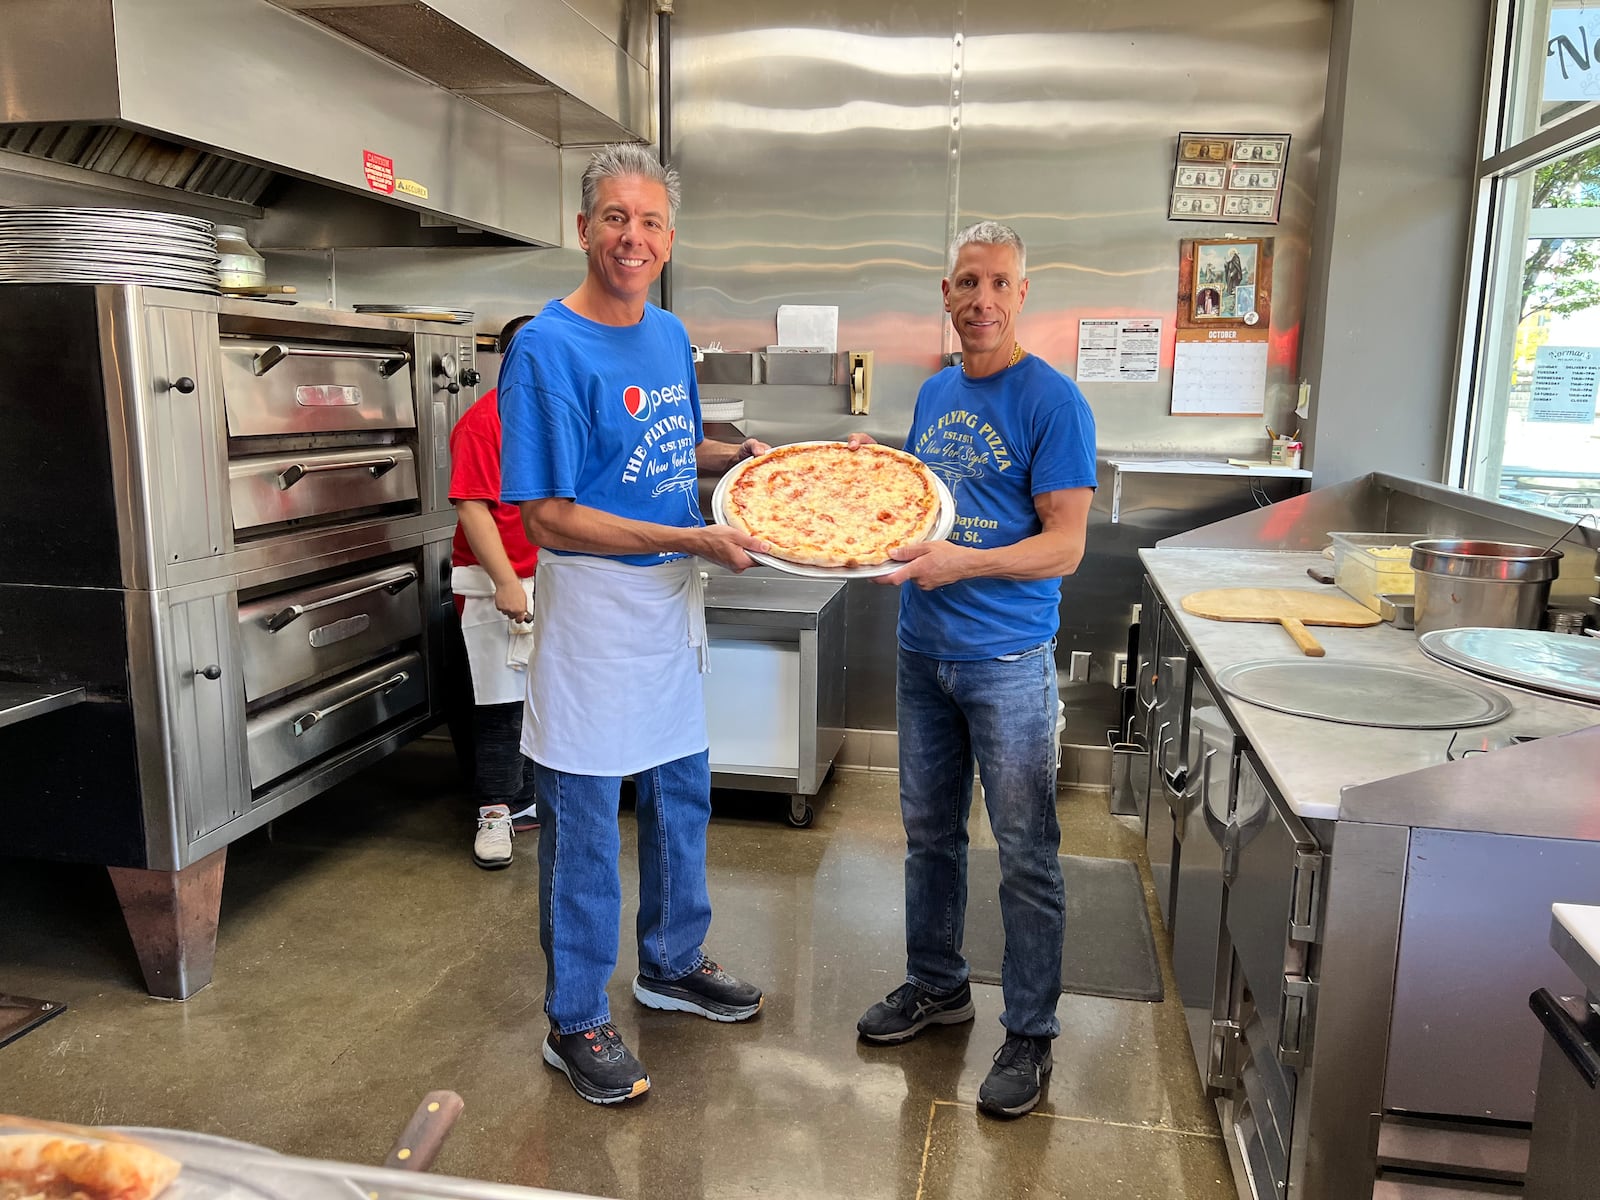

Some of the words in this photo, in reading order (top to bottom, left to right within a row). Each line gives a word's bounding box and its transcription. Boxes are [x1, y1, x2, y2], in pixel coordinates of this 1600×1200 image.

[1208, 330, 1237, 339] OCTOBER
[622, 445, 647, 484] THE
[644, 415, 687, 448] FLYING
[923, 440, 942, 455] New
[942, 442, 964, 458] York
[961, 446, 990, 468] Style
[937, 410, 978, 429] FLYING
[978, 422, 1012, 473] PIZZA
[646, 458, 669, 477] New
[671, 450, 687, 469] York
[963, 530, 982, 543] St.
